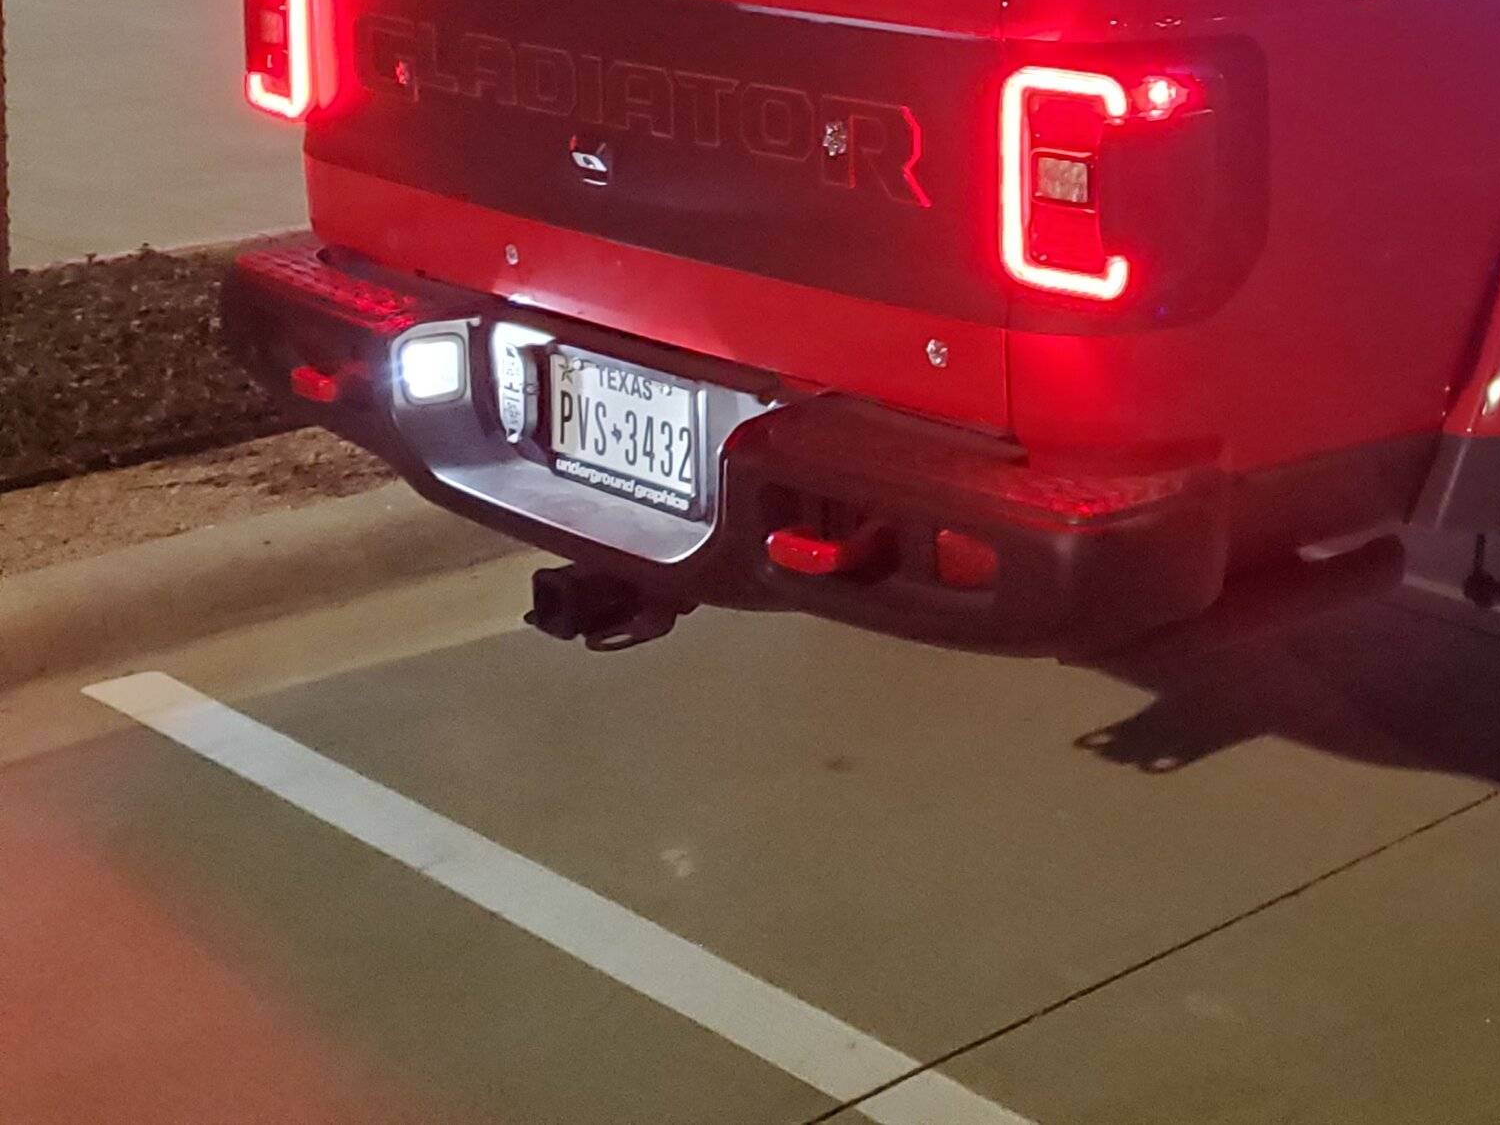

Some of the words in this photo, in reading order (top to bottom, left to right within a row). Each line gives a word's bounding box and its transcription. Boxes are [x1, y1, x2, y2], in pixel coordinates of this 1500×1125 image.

[356, 13, 932, 208] GLADIATOR
[598, 367, 653, 401] TEXAS
[555, 458, 636, 493] underground
